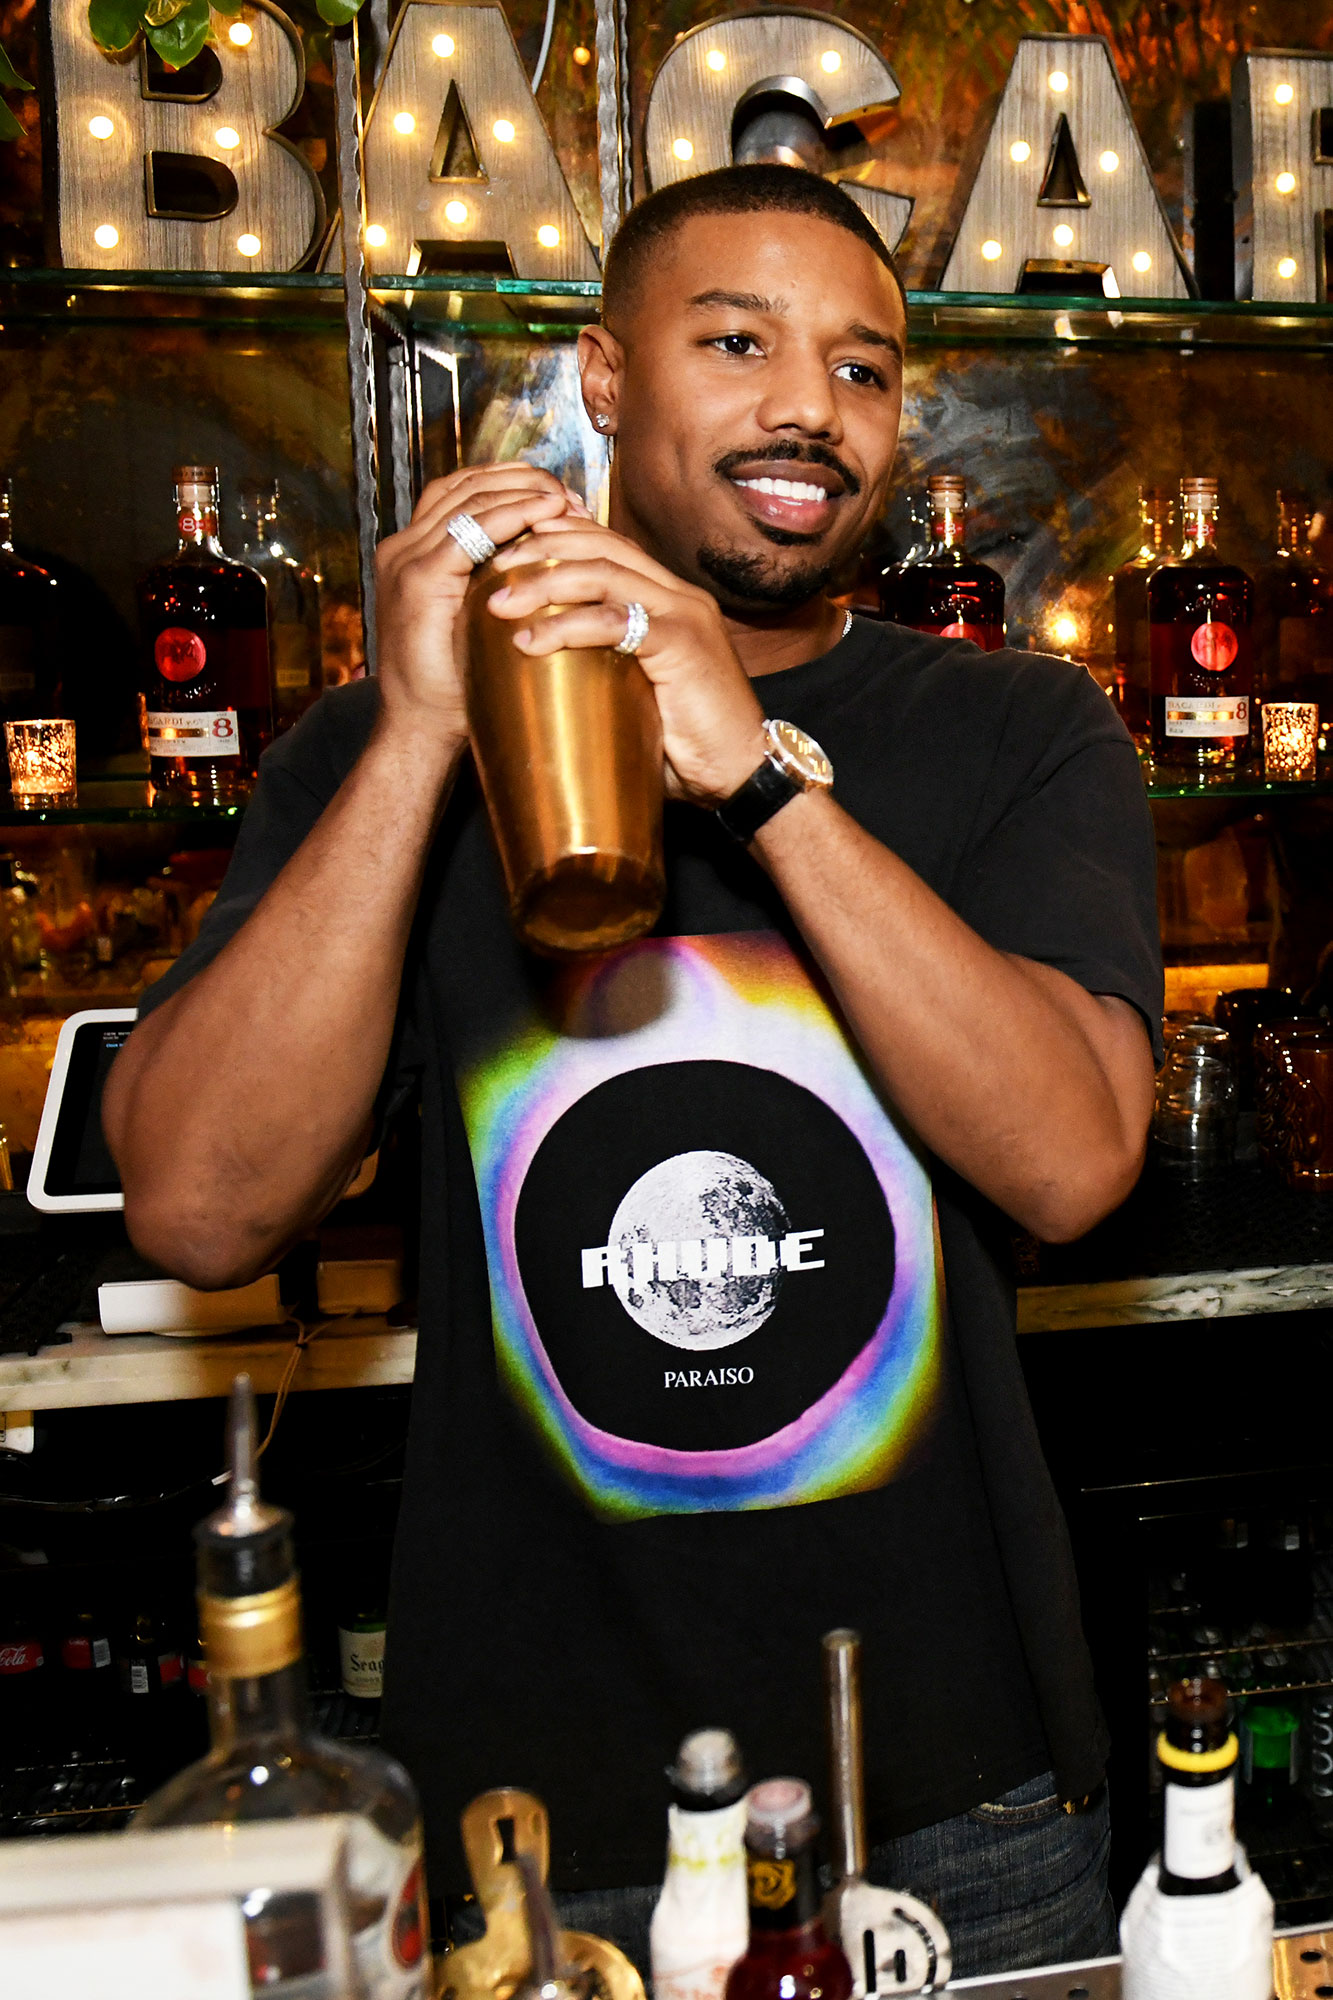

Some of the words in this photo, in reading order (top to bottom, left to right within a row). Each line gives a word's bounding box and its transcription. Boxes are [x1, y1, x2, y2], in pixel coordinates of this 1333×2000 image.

[183, 518, 195, 532] 8
[1236, 702, 1247, 719] 8
[212, 718, 234, 738] 8
[581, 1229, 825, 1288] RHUDE
[664, 1367, 754, 1388] PARAISO
